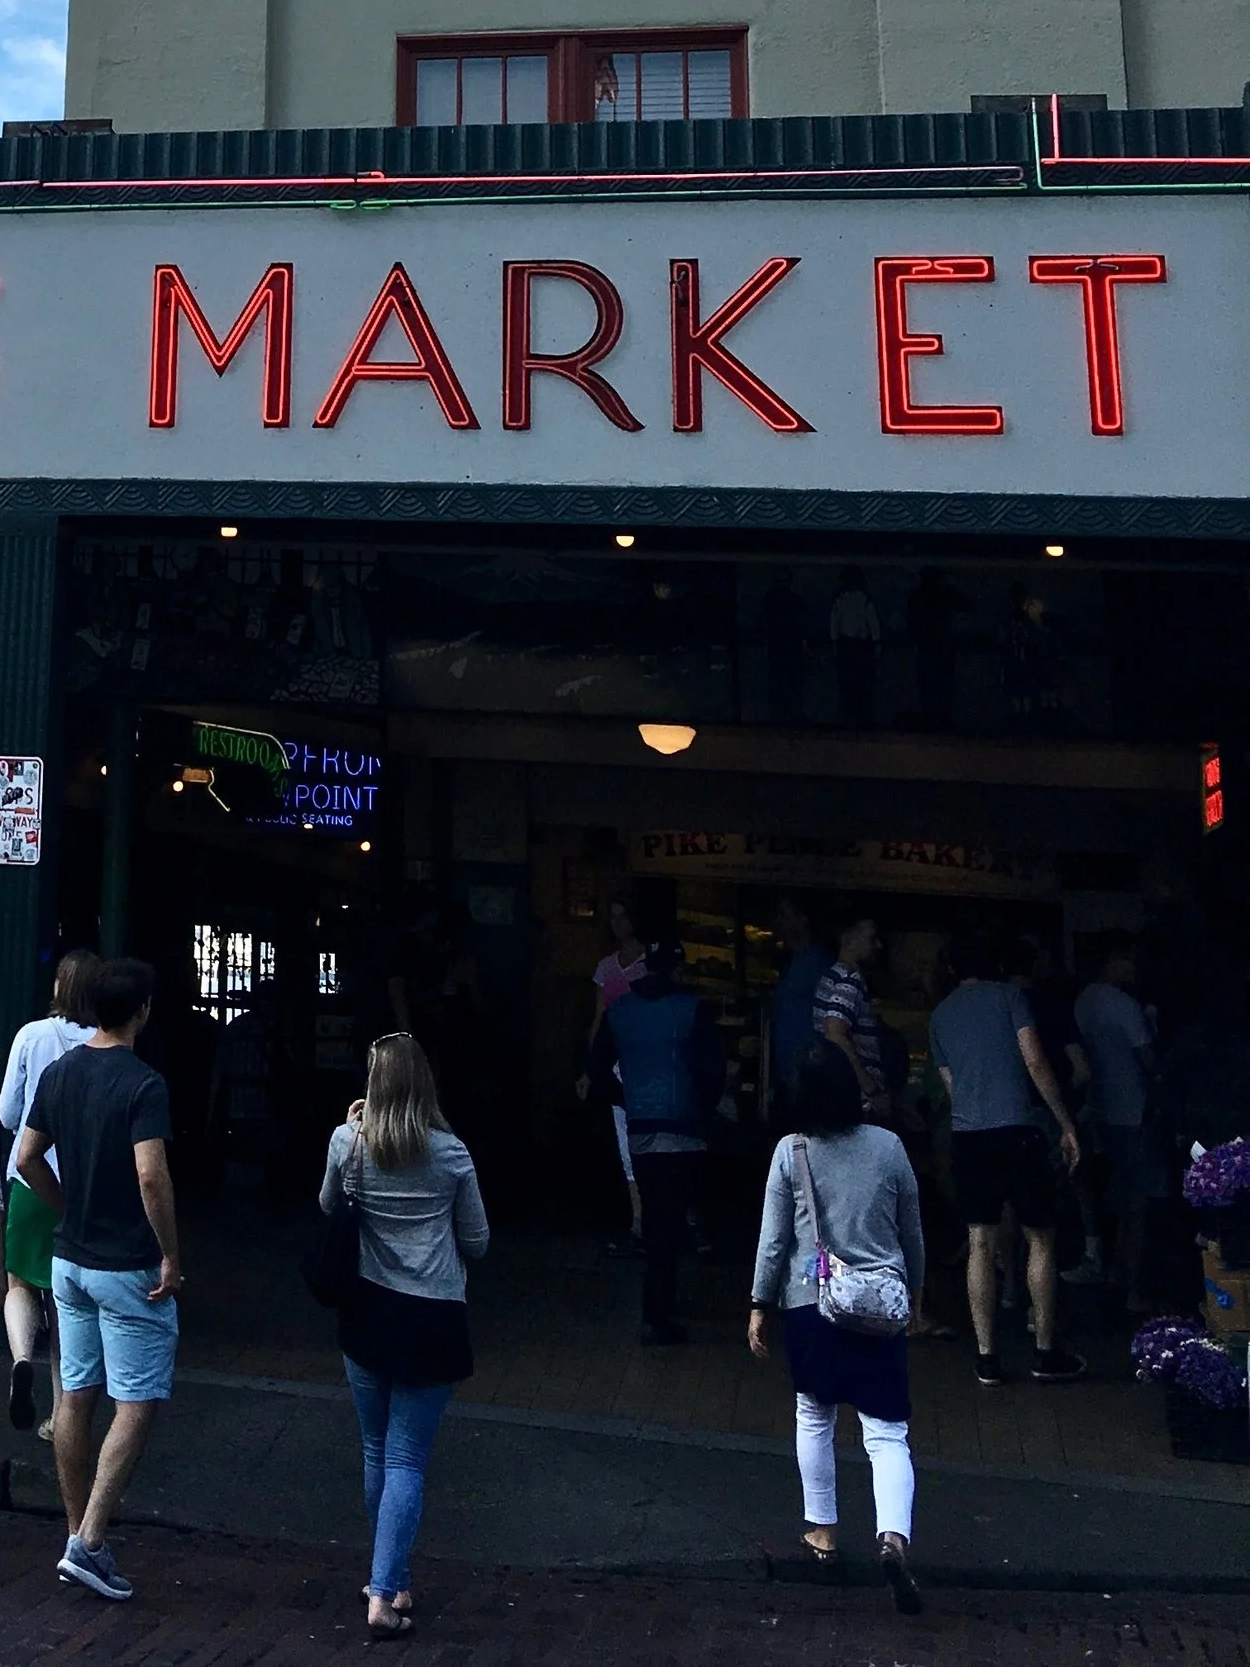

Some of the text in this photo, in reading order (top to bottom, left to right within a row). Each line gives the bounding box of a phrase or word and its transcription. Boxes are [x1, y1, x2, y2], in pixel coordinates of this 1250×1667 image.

[148, 254, 1168, 437] MARKET
[283, 784, 379, 811] POINT
[302, 812, 353, 827] SEATING
[642, 833, 728, 859] PIKE
